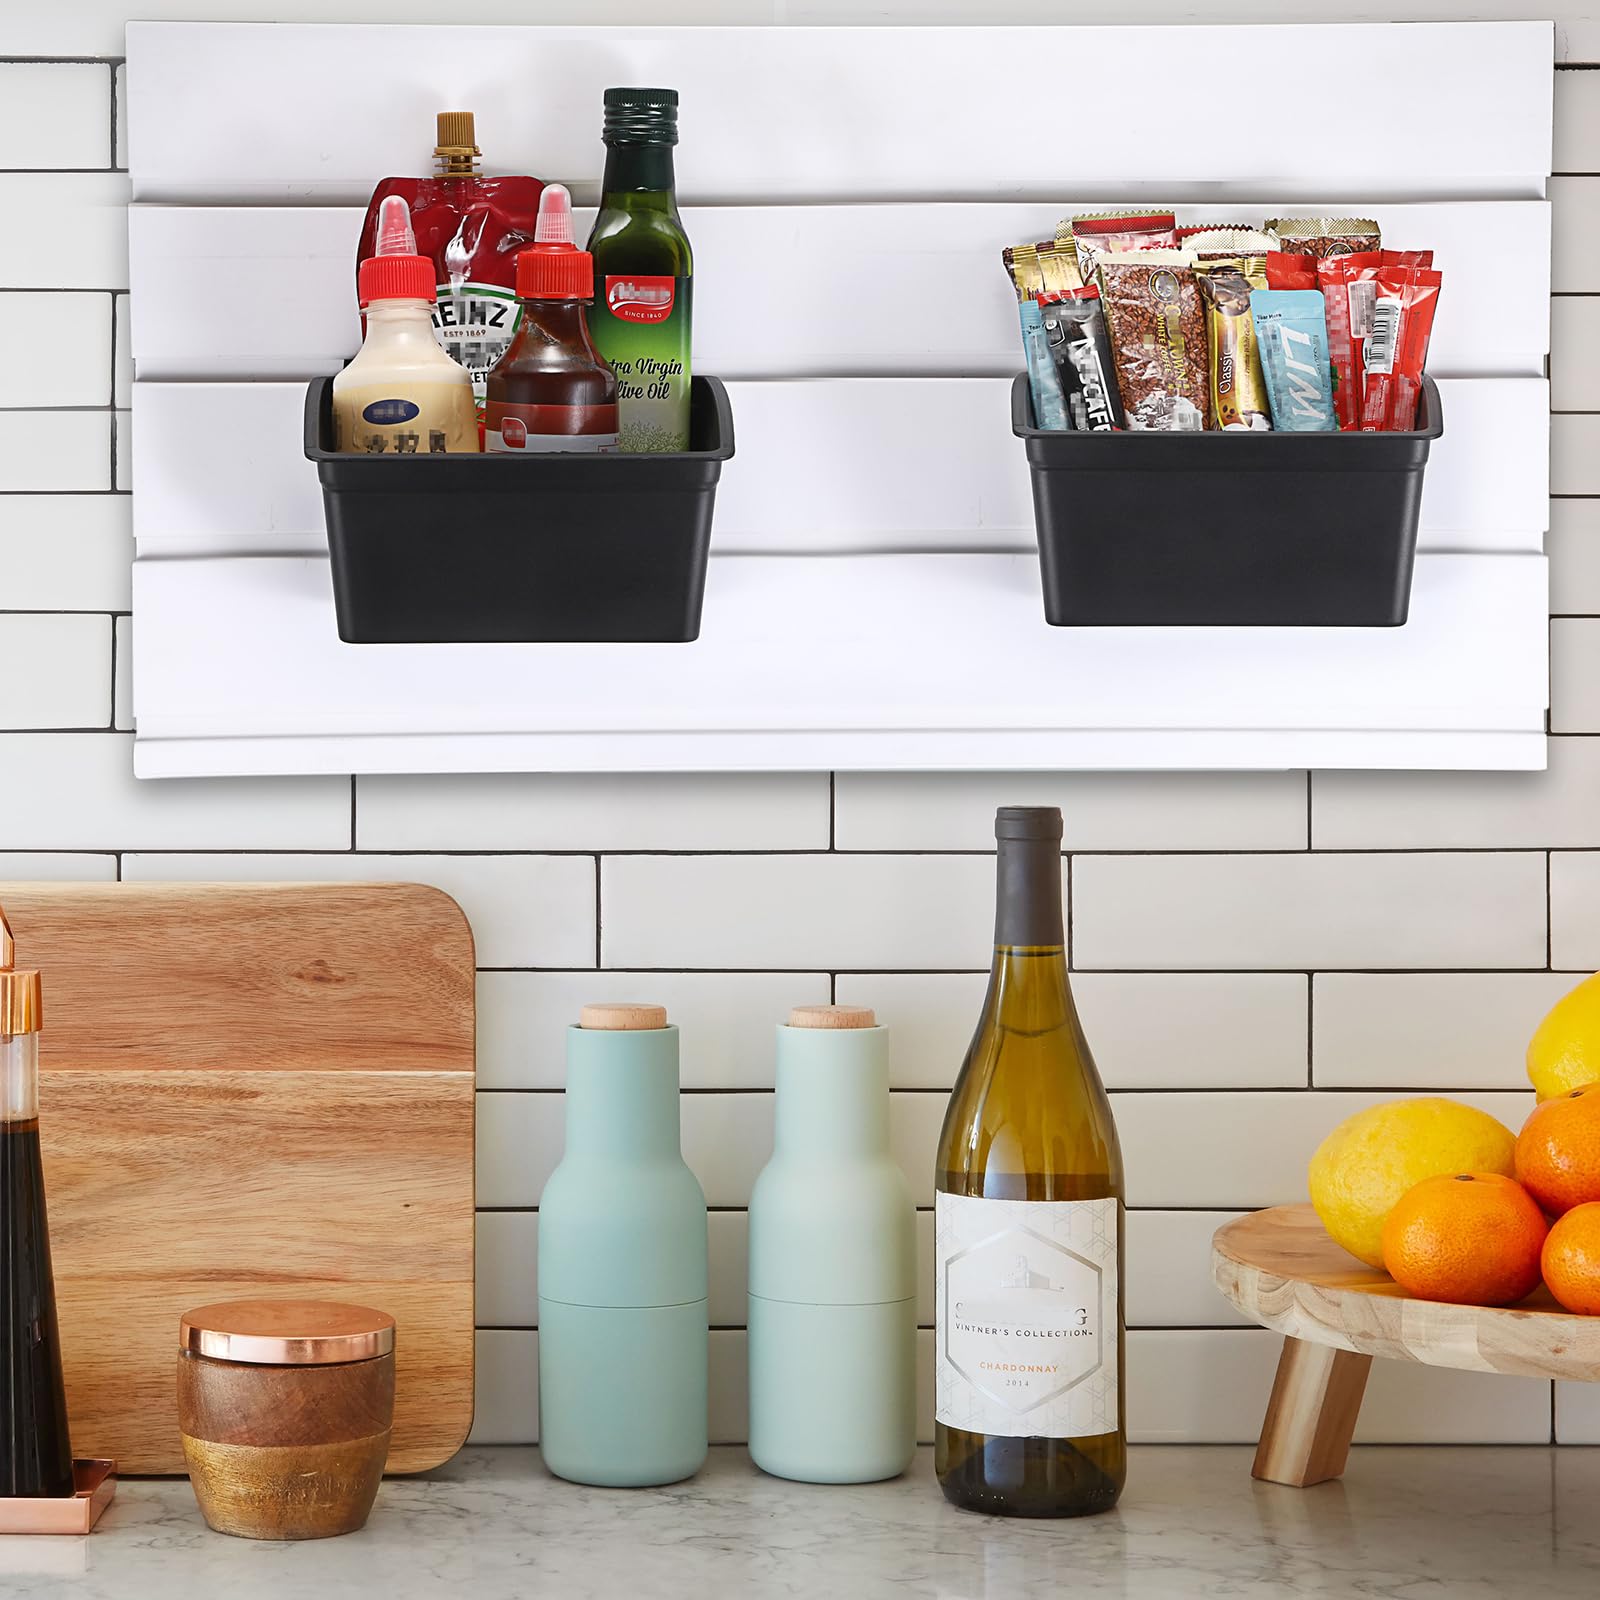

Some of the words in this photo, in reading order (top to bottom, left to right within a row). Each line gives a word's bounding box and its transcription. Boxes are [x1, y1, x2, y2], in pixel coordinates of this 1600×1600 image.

[624, 310, 645, 319] SINCE
[466, 329, 487, 337] 1869
[1156, 313, 1166, 344] WHITE
[1159, 345, 1172, 373] COFFEE
[608, 358, 633, 375] tra
[635, 357, 683, 381] Virgin
[1218, 349, 1233, 394] Classic
[618, 380, 644, 399] live
[647, 382, 670, 399] Oil
[955, 1322, 1009, 1336] VINTNER'S
[979, 1361, 1058, 1373] CHARDONNAY
[1006, 1379, 1030, 1387] 2014
